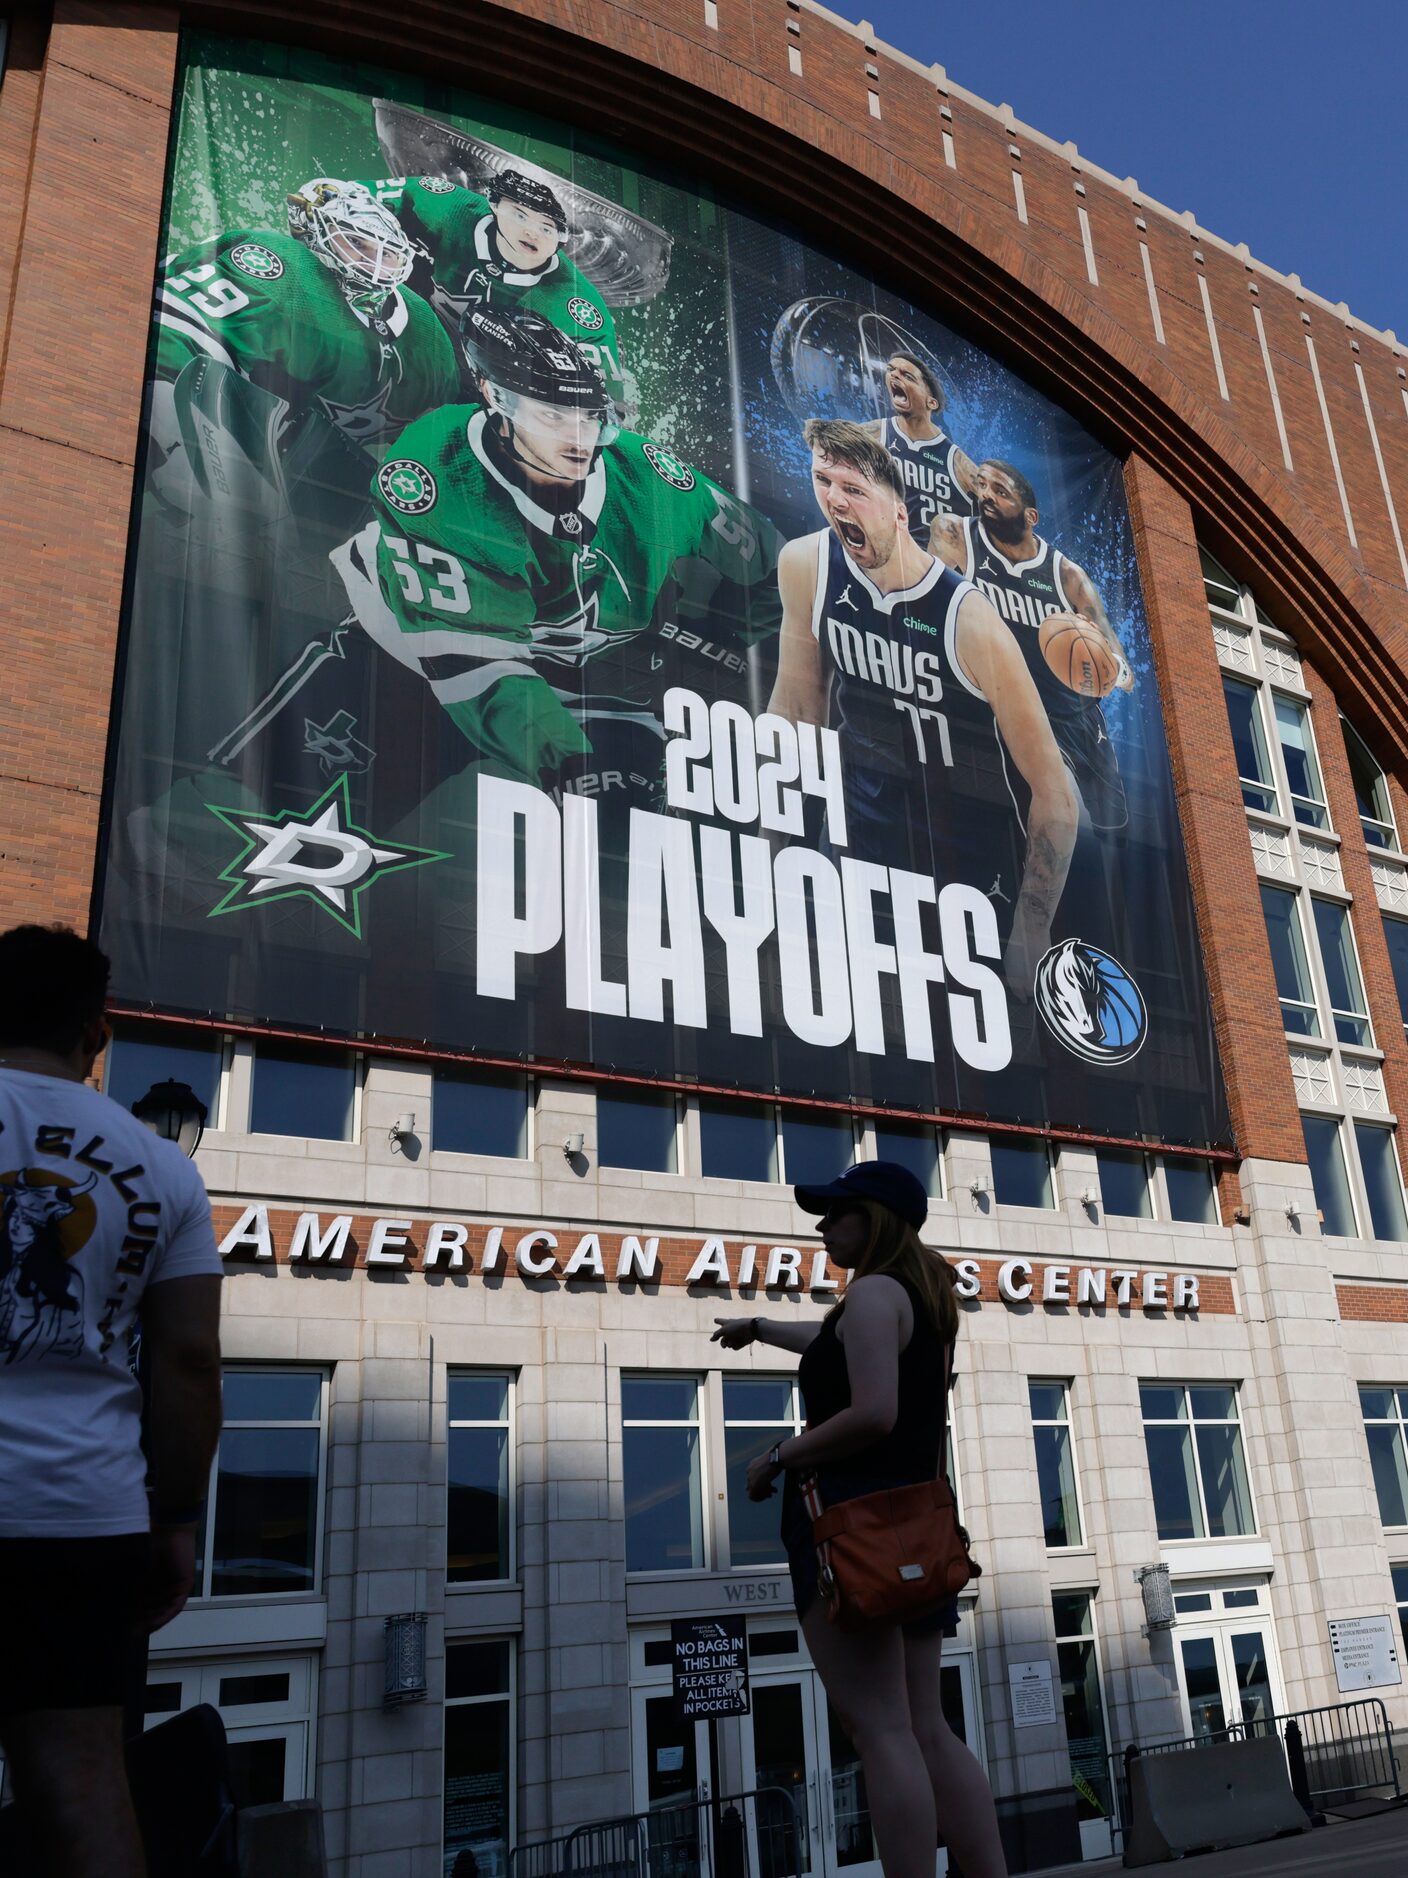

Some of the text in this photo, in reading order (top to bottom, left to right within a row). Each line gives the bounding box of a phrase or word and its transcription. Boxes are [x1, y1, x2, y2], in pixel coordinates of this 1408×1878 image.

[164, 263, 250, 318] 29
[483, 318, 511, 337] ENERGY
[922, 452, 945, 466] chime
[381, 463, 432, 510] DALLAS STARS
[1027, 578, 1054, 593] chime
[903, 616, 937, 637] chime
[827, 616, 943, 704] MAVS
[893, 697, 955, 768] 77
[663, 686, 848, 847] 2024
[476, 773, 1013, 1072] PLAYOFFS
[218, 1203, 1201, 1311] AMERICAN AIRLS CENTER
[724, 1582, 781, 1602] WEST
[676, 1637, 744, 1656] NO BAGS IN
[683, 1654, 738, 1671] THIS LINE
[680, 1675, 717, 1688] PLEASE
[687, 1688, 707, 1701] ALL
[683, 1703, 694, 1714] IN
